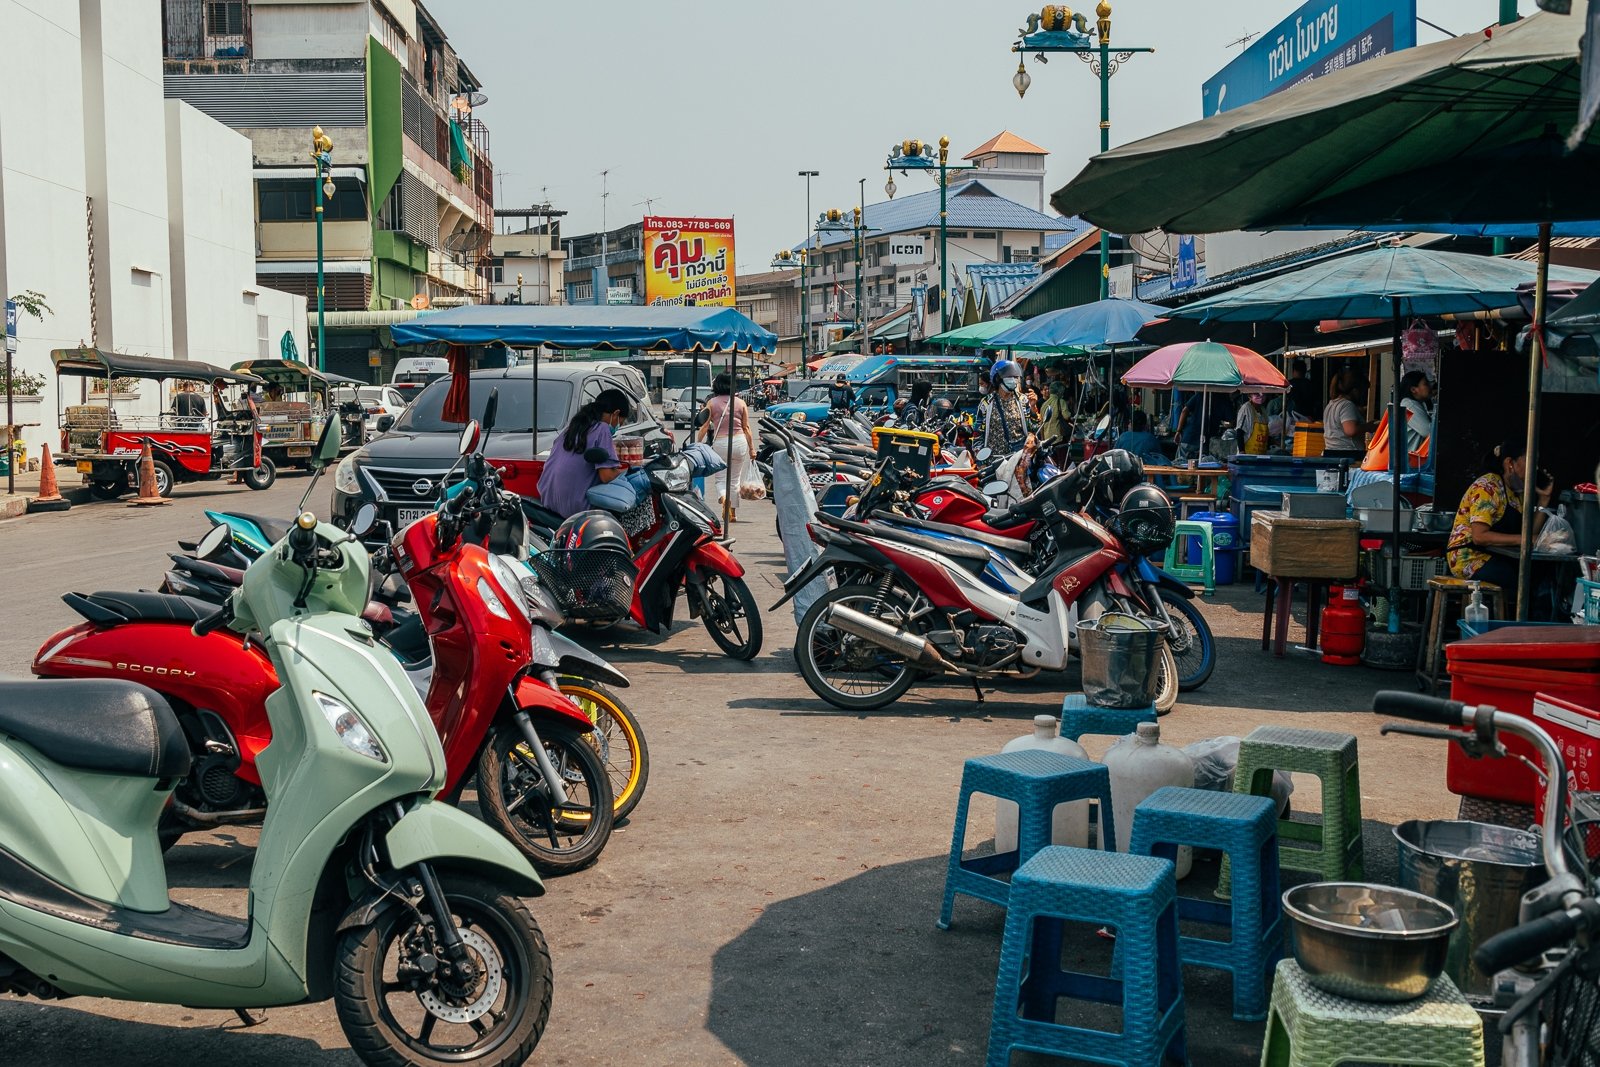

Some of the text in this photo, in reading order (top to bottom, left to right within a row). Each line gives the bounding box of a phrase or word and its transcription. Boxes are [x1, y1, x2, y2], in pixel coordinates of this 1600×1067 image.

[1268, 4, 1339, 82] ทวิน โมบาย
[647, 218, 731, 230] โทร.083-7788-669
[653, 230, 704, 279] คุ้ม
[685, 248, 727, 277] กว่านี้
[685, 273, 728, 290] ไม่มีอีกแล้ว
